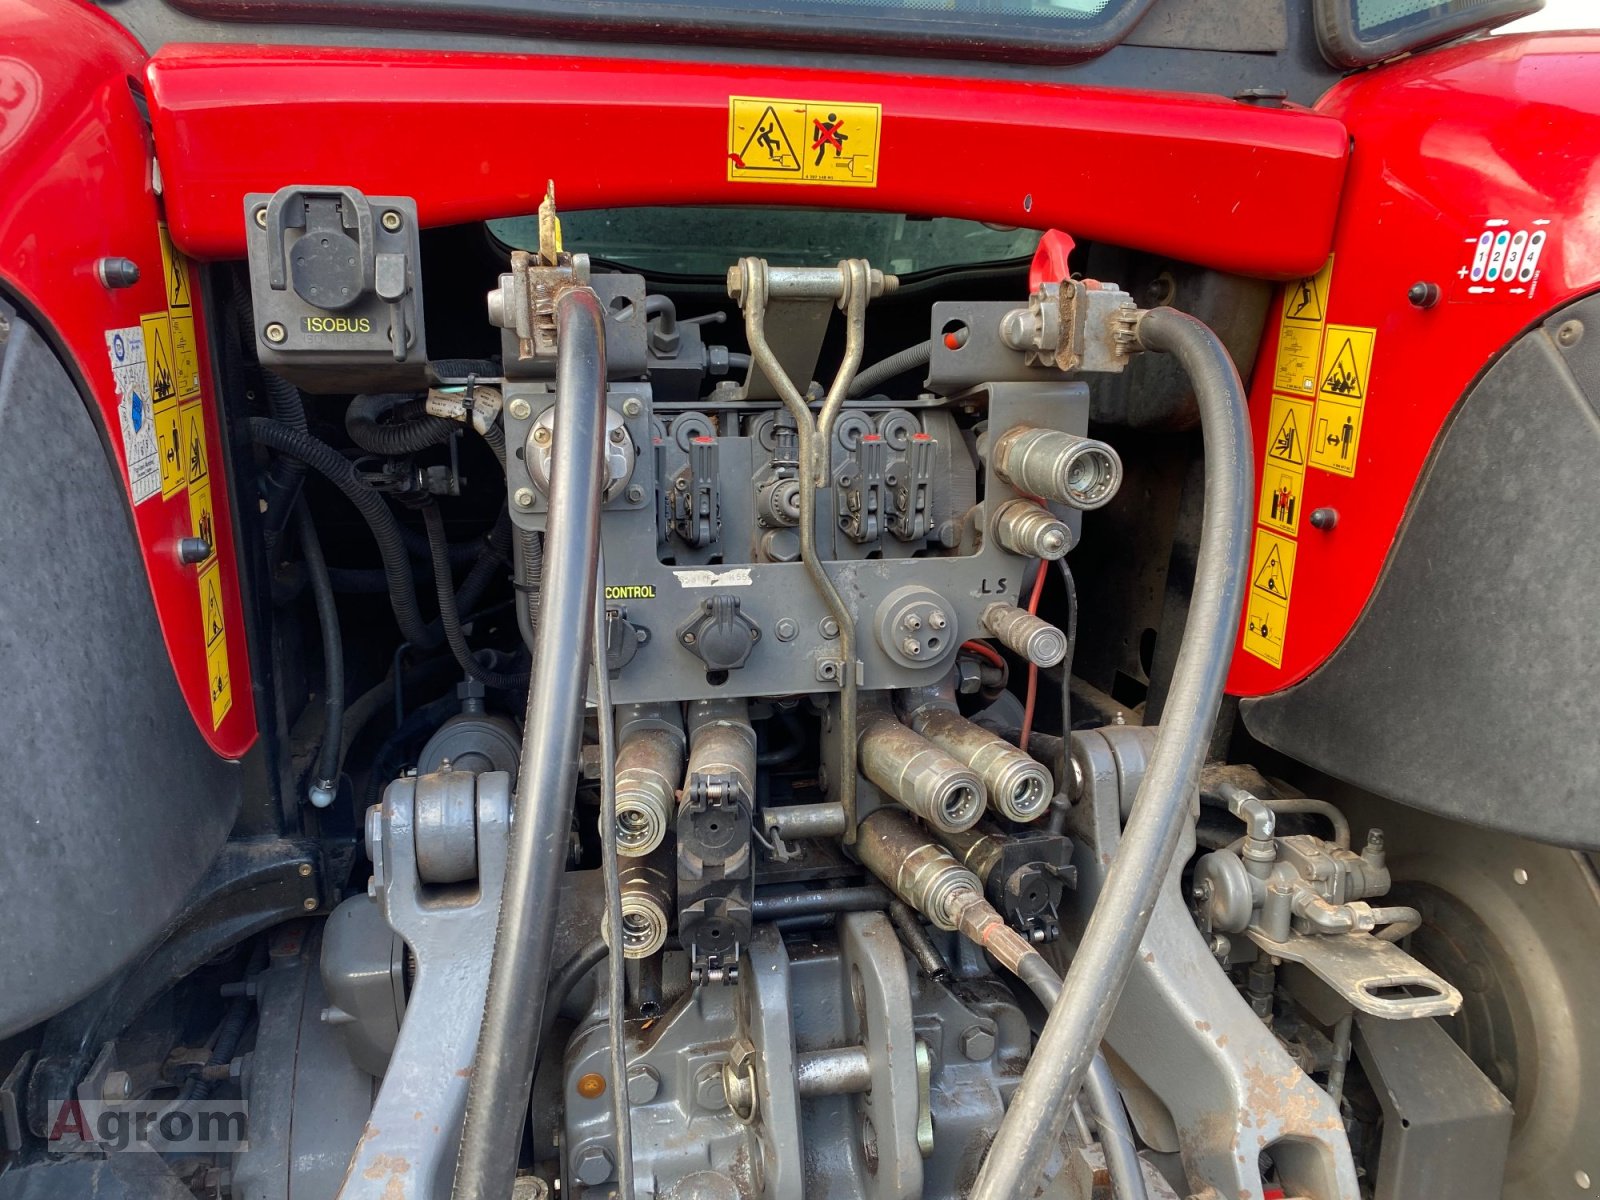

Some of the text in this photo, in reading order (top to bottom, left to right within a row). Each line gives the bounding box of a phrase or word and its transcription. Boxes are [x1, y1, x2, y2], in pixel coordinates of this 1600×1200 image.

[1480, 252, 1534, 262] 1 2 3 4
[307, 318, 370, 332] ISOBUS
[605, 586, 655, 598] CONTROL
